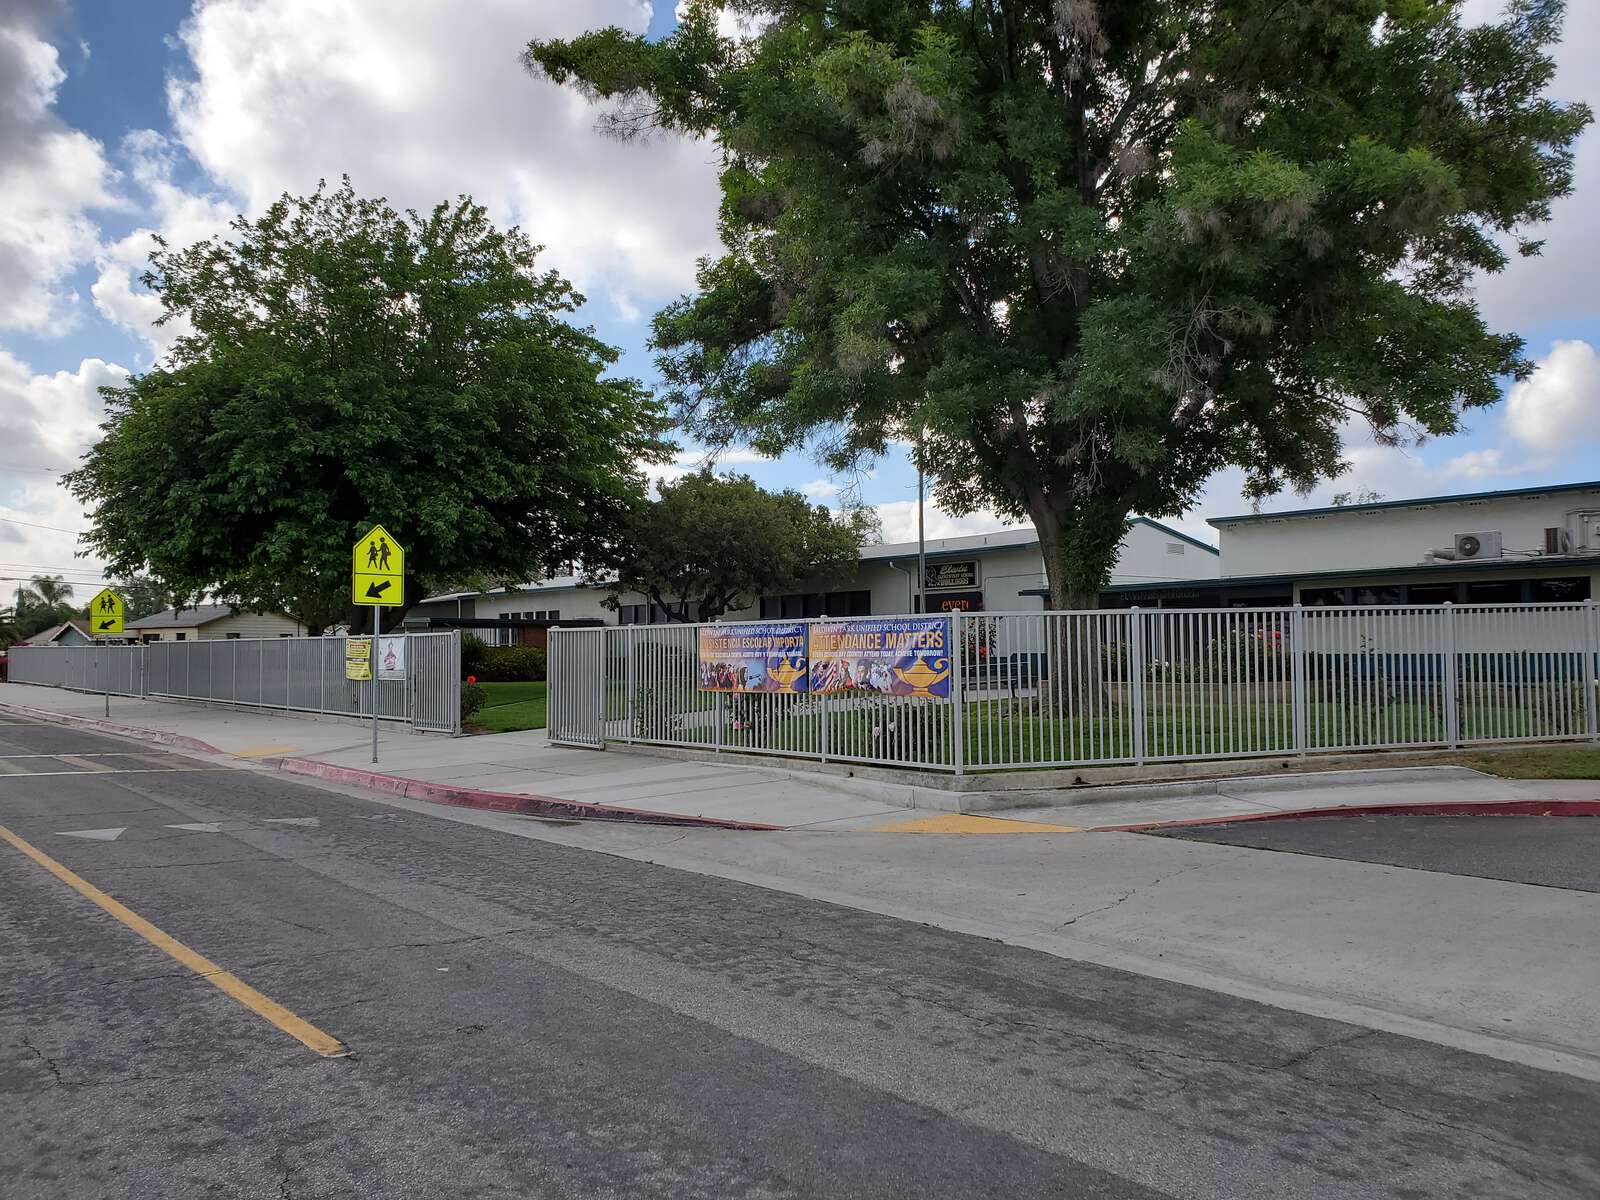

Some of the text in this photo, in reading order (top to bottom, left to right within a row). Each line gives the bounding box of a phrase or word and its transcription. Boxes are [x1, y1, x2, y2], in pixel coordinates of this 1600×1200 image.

[856, 623, 881, 632] UNIFIED
[883, 622, 910, 631] SCHOOL
[912, 621, 943, 630] DISTRICT
[742, 636, 771, 649] ESCOLAR
[812, 631, 944, 651] ATTENDANCE MATTERS
